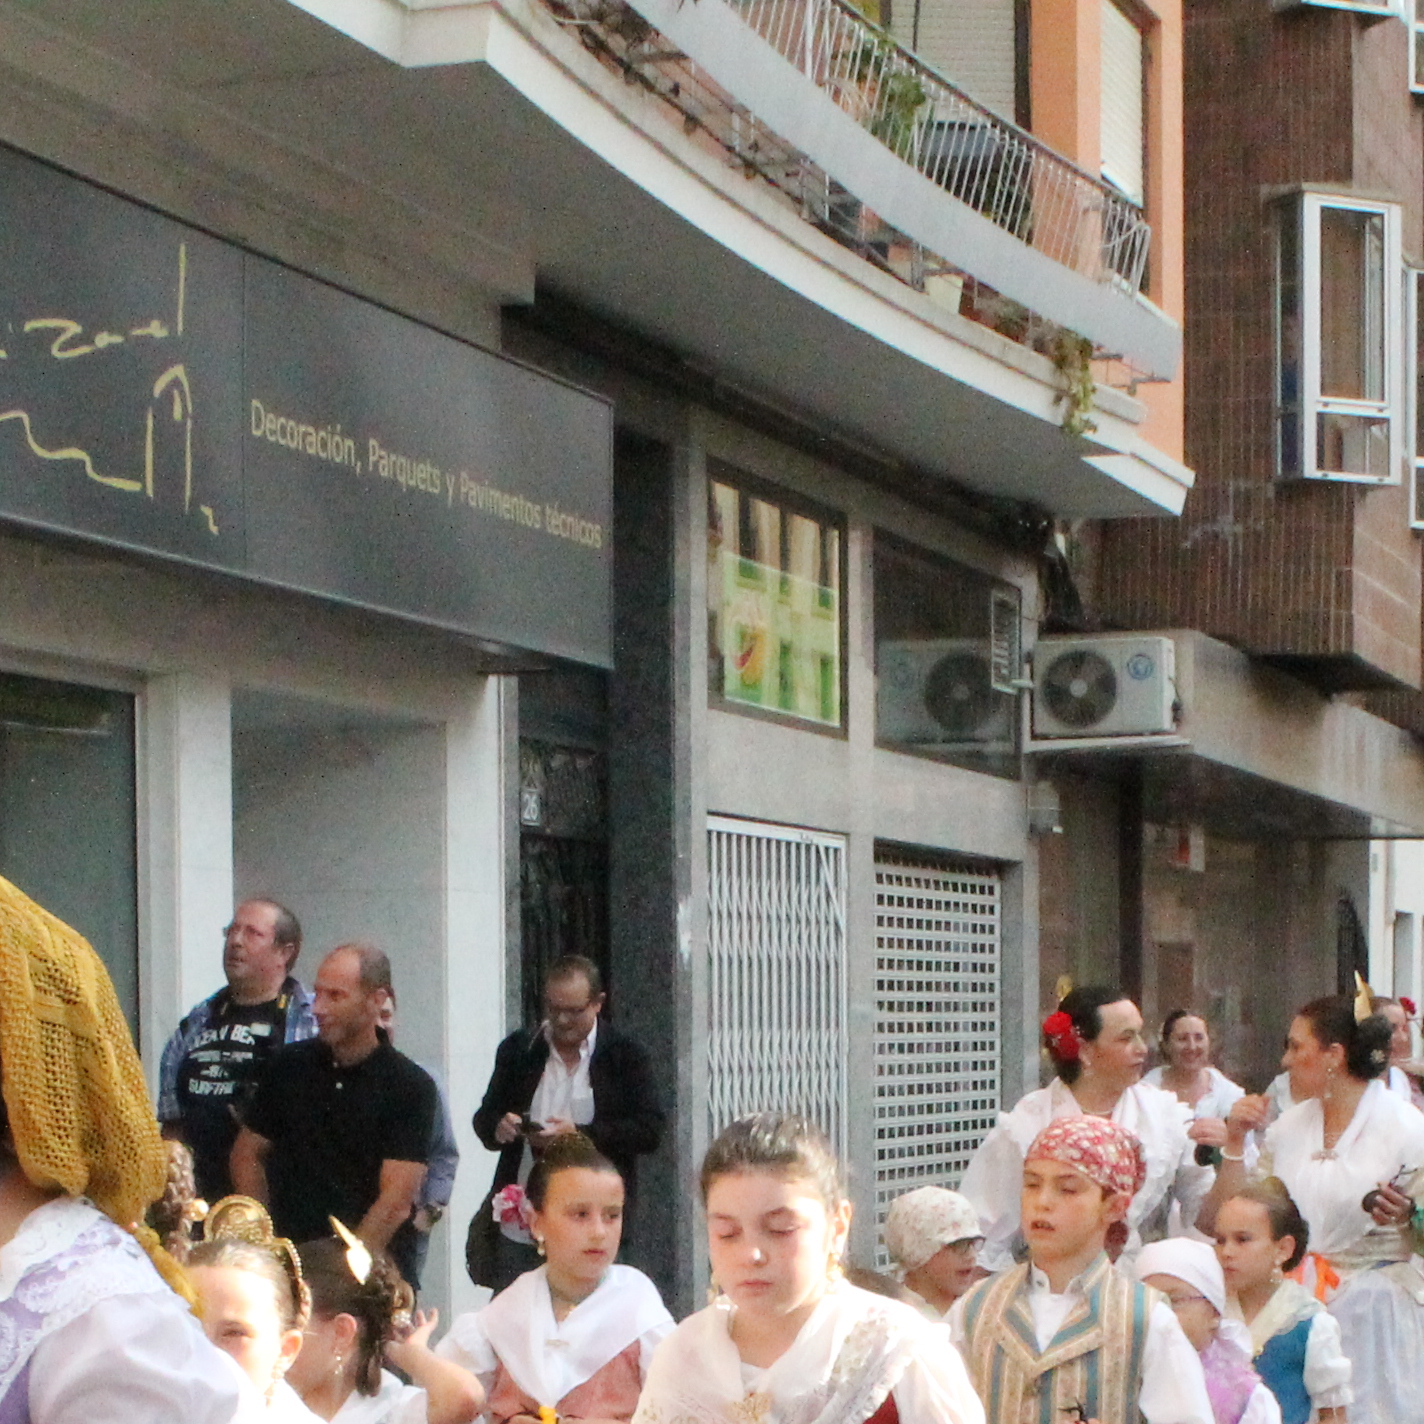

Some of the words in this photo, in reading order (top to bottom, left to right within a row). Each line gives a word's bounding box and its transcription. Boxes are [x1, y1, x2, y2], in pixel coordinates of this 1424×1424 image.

[251, 399, 362, 477] Decoración,
[369, 438, 441, 493] Parquets
[445, 472, 456, 507] y
[460, 470, 542, 530] Pavimentos
[545, 500, 603, 549] técnicos
